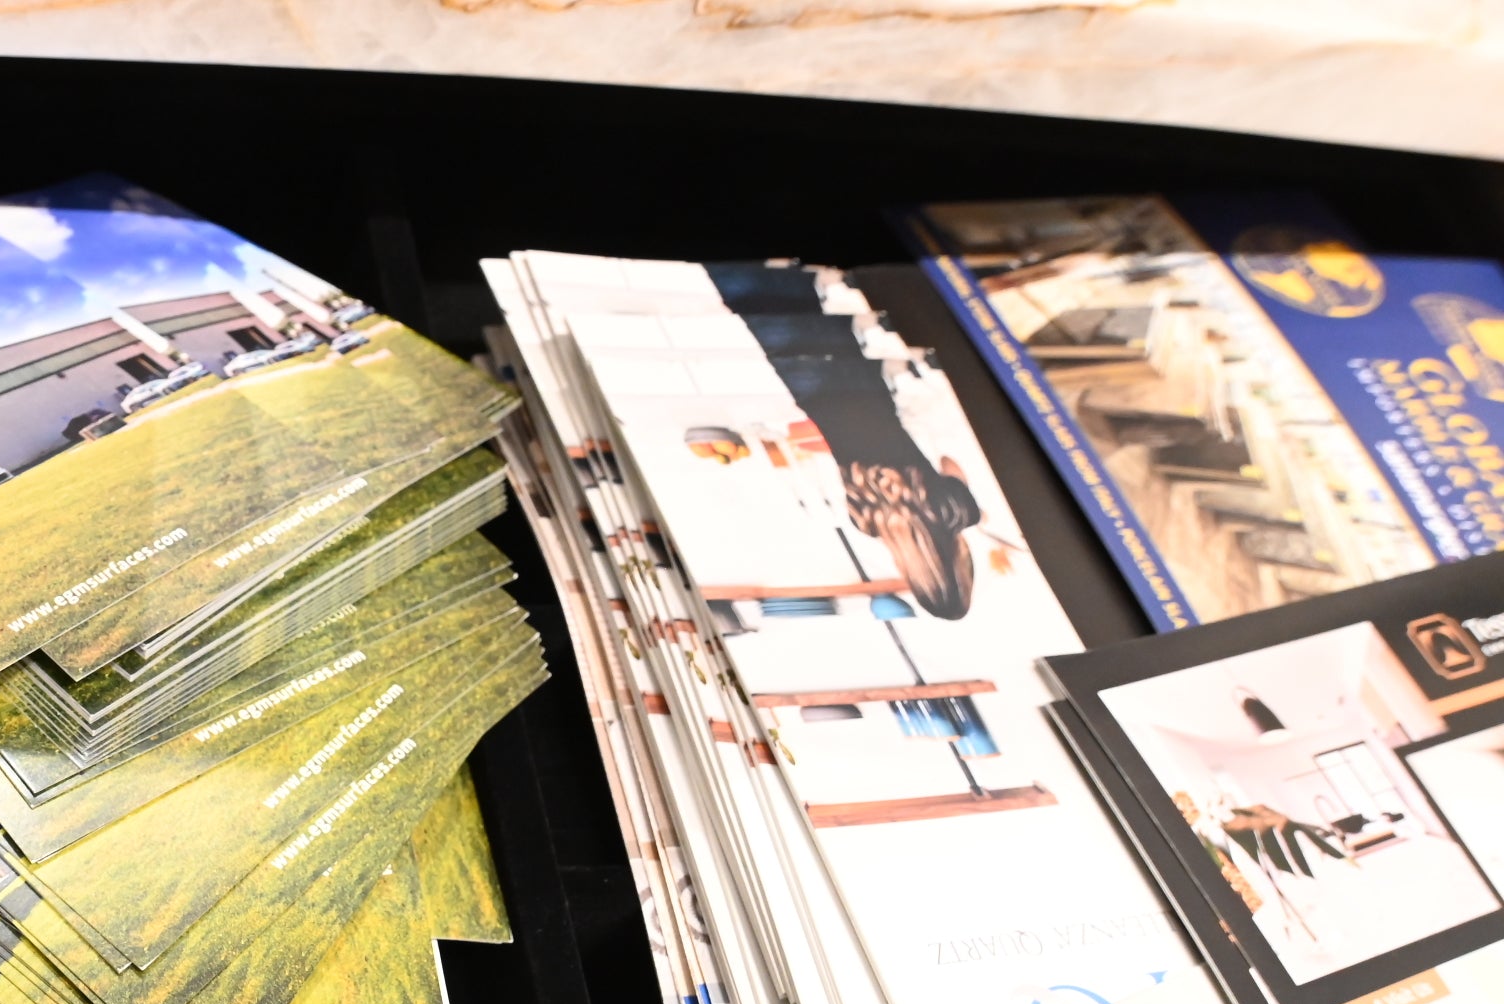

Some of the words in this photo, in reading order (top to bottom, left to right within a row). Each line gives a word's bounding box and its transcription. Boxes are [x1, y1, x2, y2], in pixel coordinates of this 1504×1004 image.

[212, 475, 368, 570] www.egmsurfaces.com
[6, 526, 189, 633] www.egmsurfaces.com
[194, 650, 367, 744] www.egmsurfaces.com
[262, 683, 405, 809] www.egmsurfaces.com
[269, 736, 417, 870] www.egmsurfaces.com
[927, 929, 1044, 965] QUARTZ
